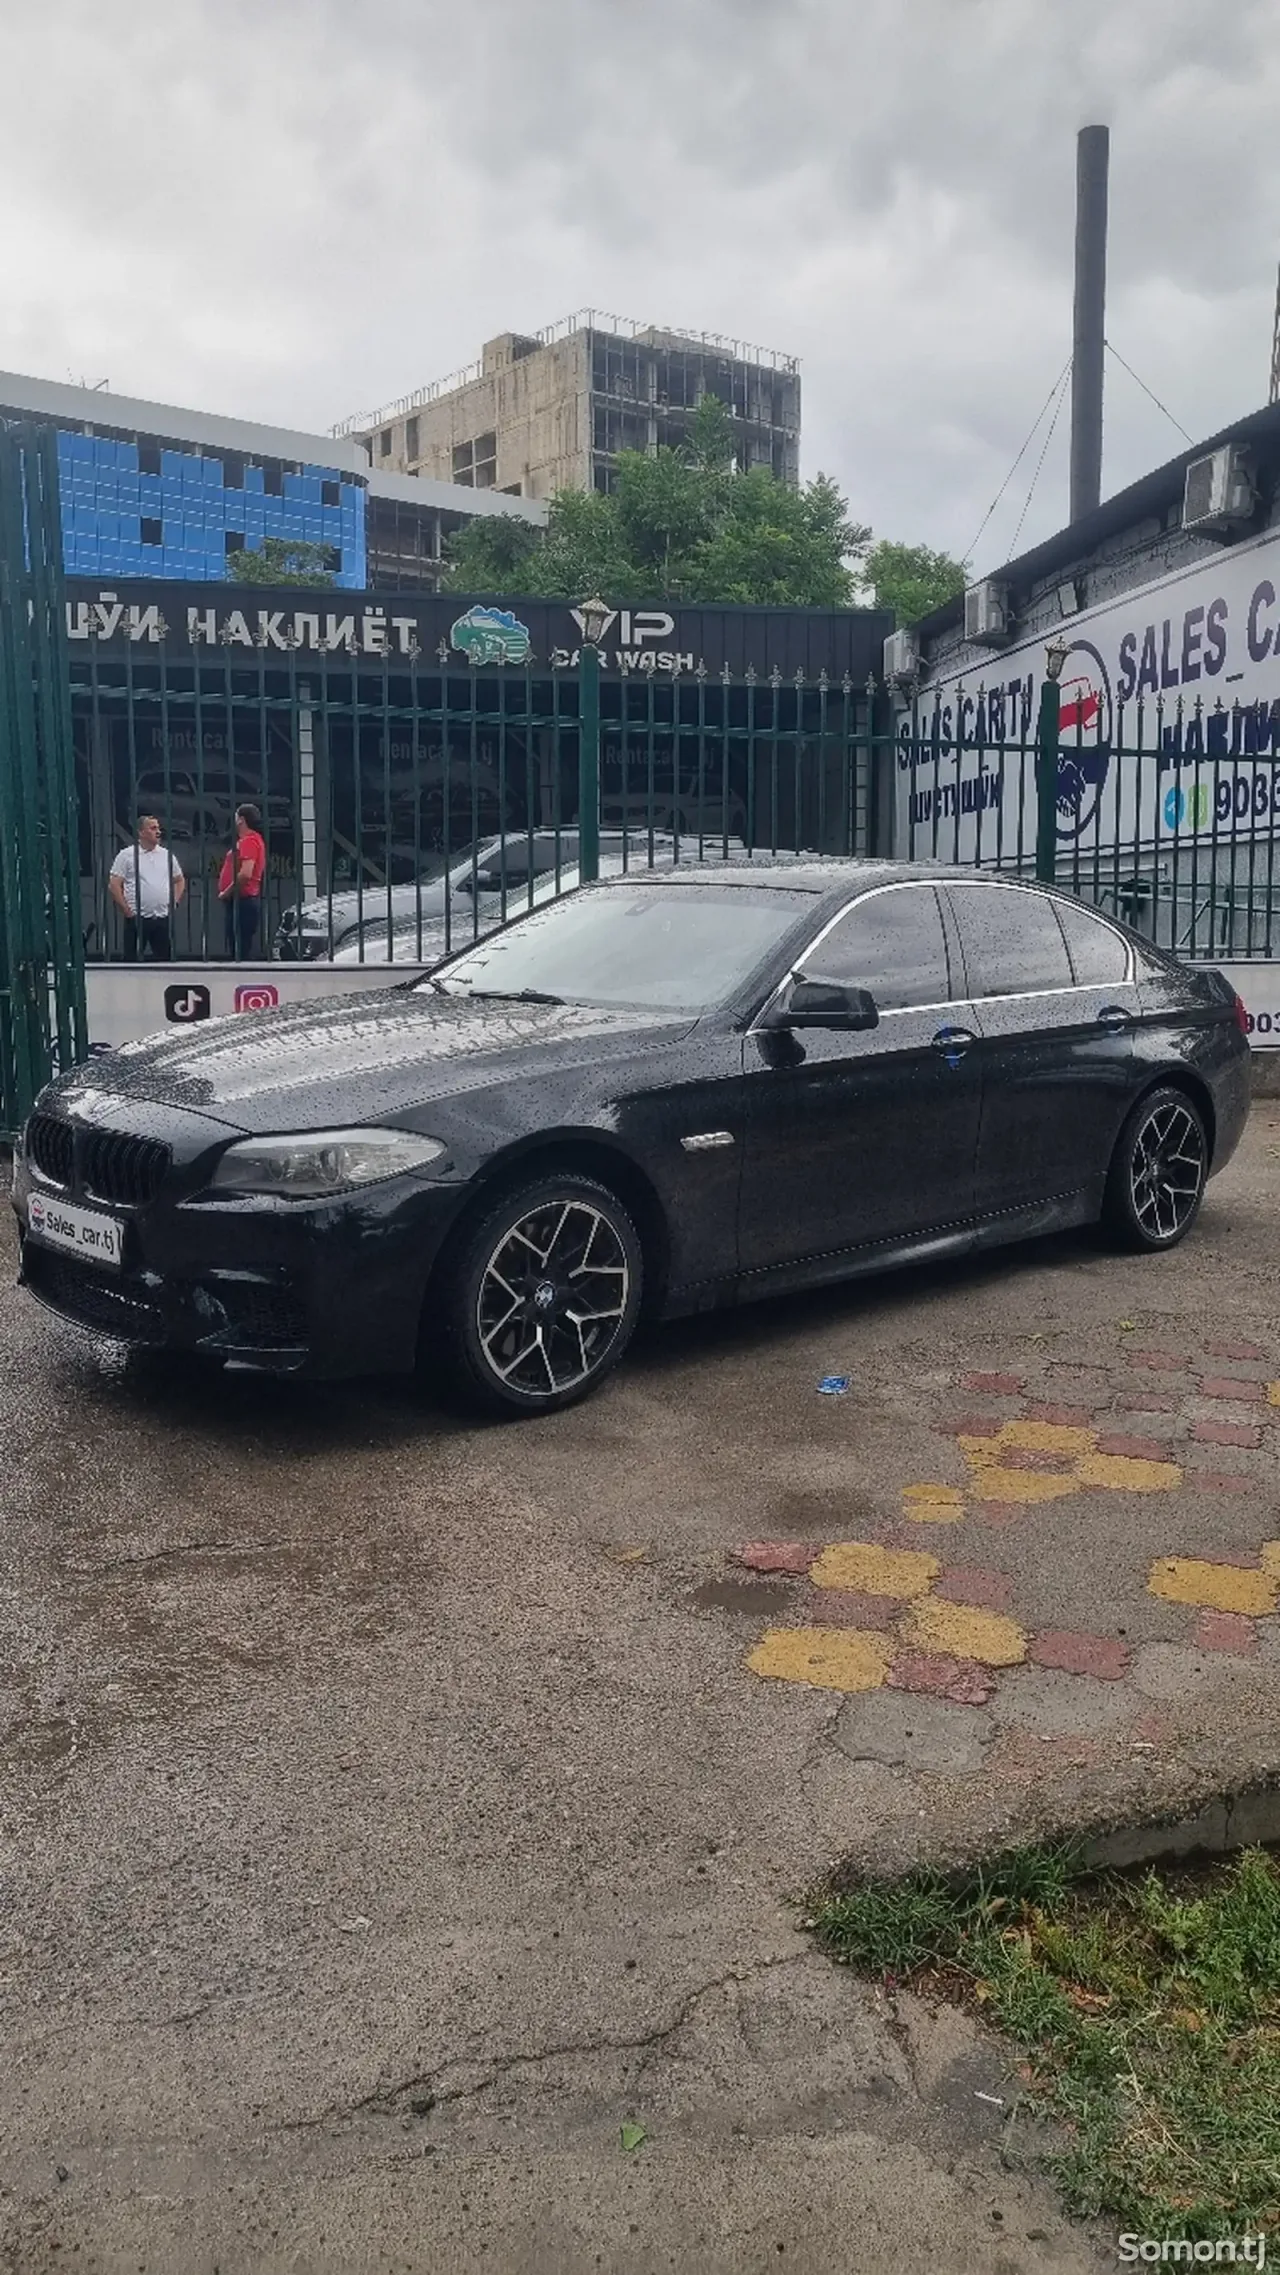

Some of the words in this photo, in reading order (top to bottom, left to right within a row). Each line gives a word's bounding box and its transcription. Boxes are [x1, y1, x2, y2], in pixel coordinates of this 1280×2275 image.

[187, 606, 418, 652] НАКЛИЁТ
[569, 609, 675, 645] VIP
[616, 651, 693, 670] WASH
[46, 1211, 114, 1255] Sales_car.tj
